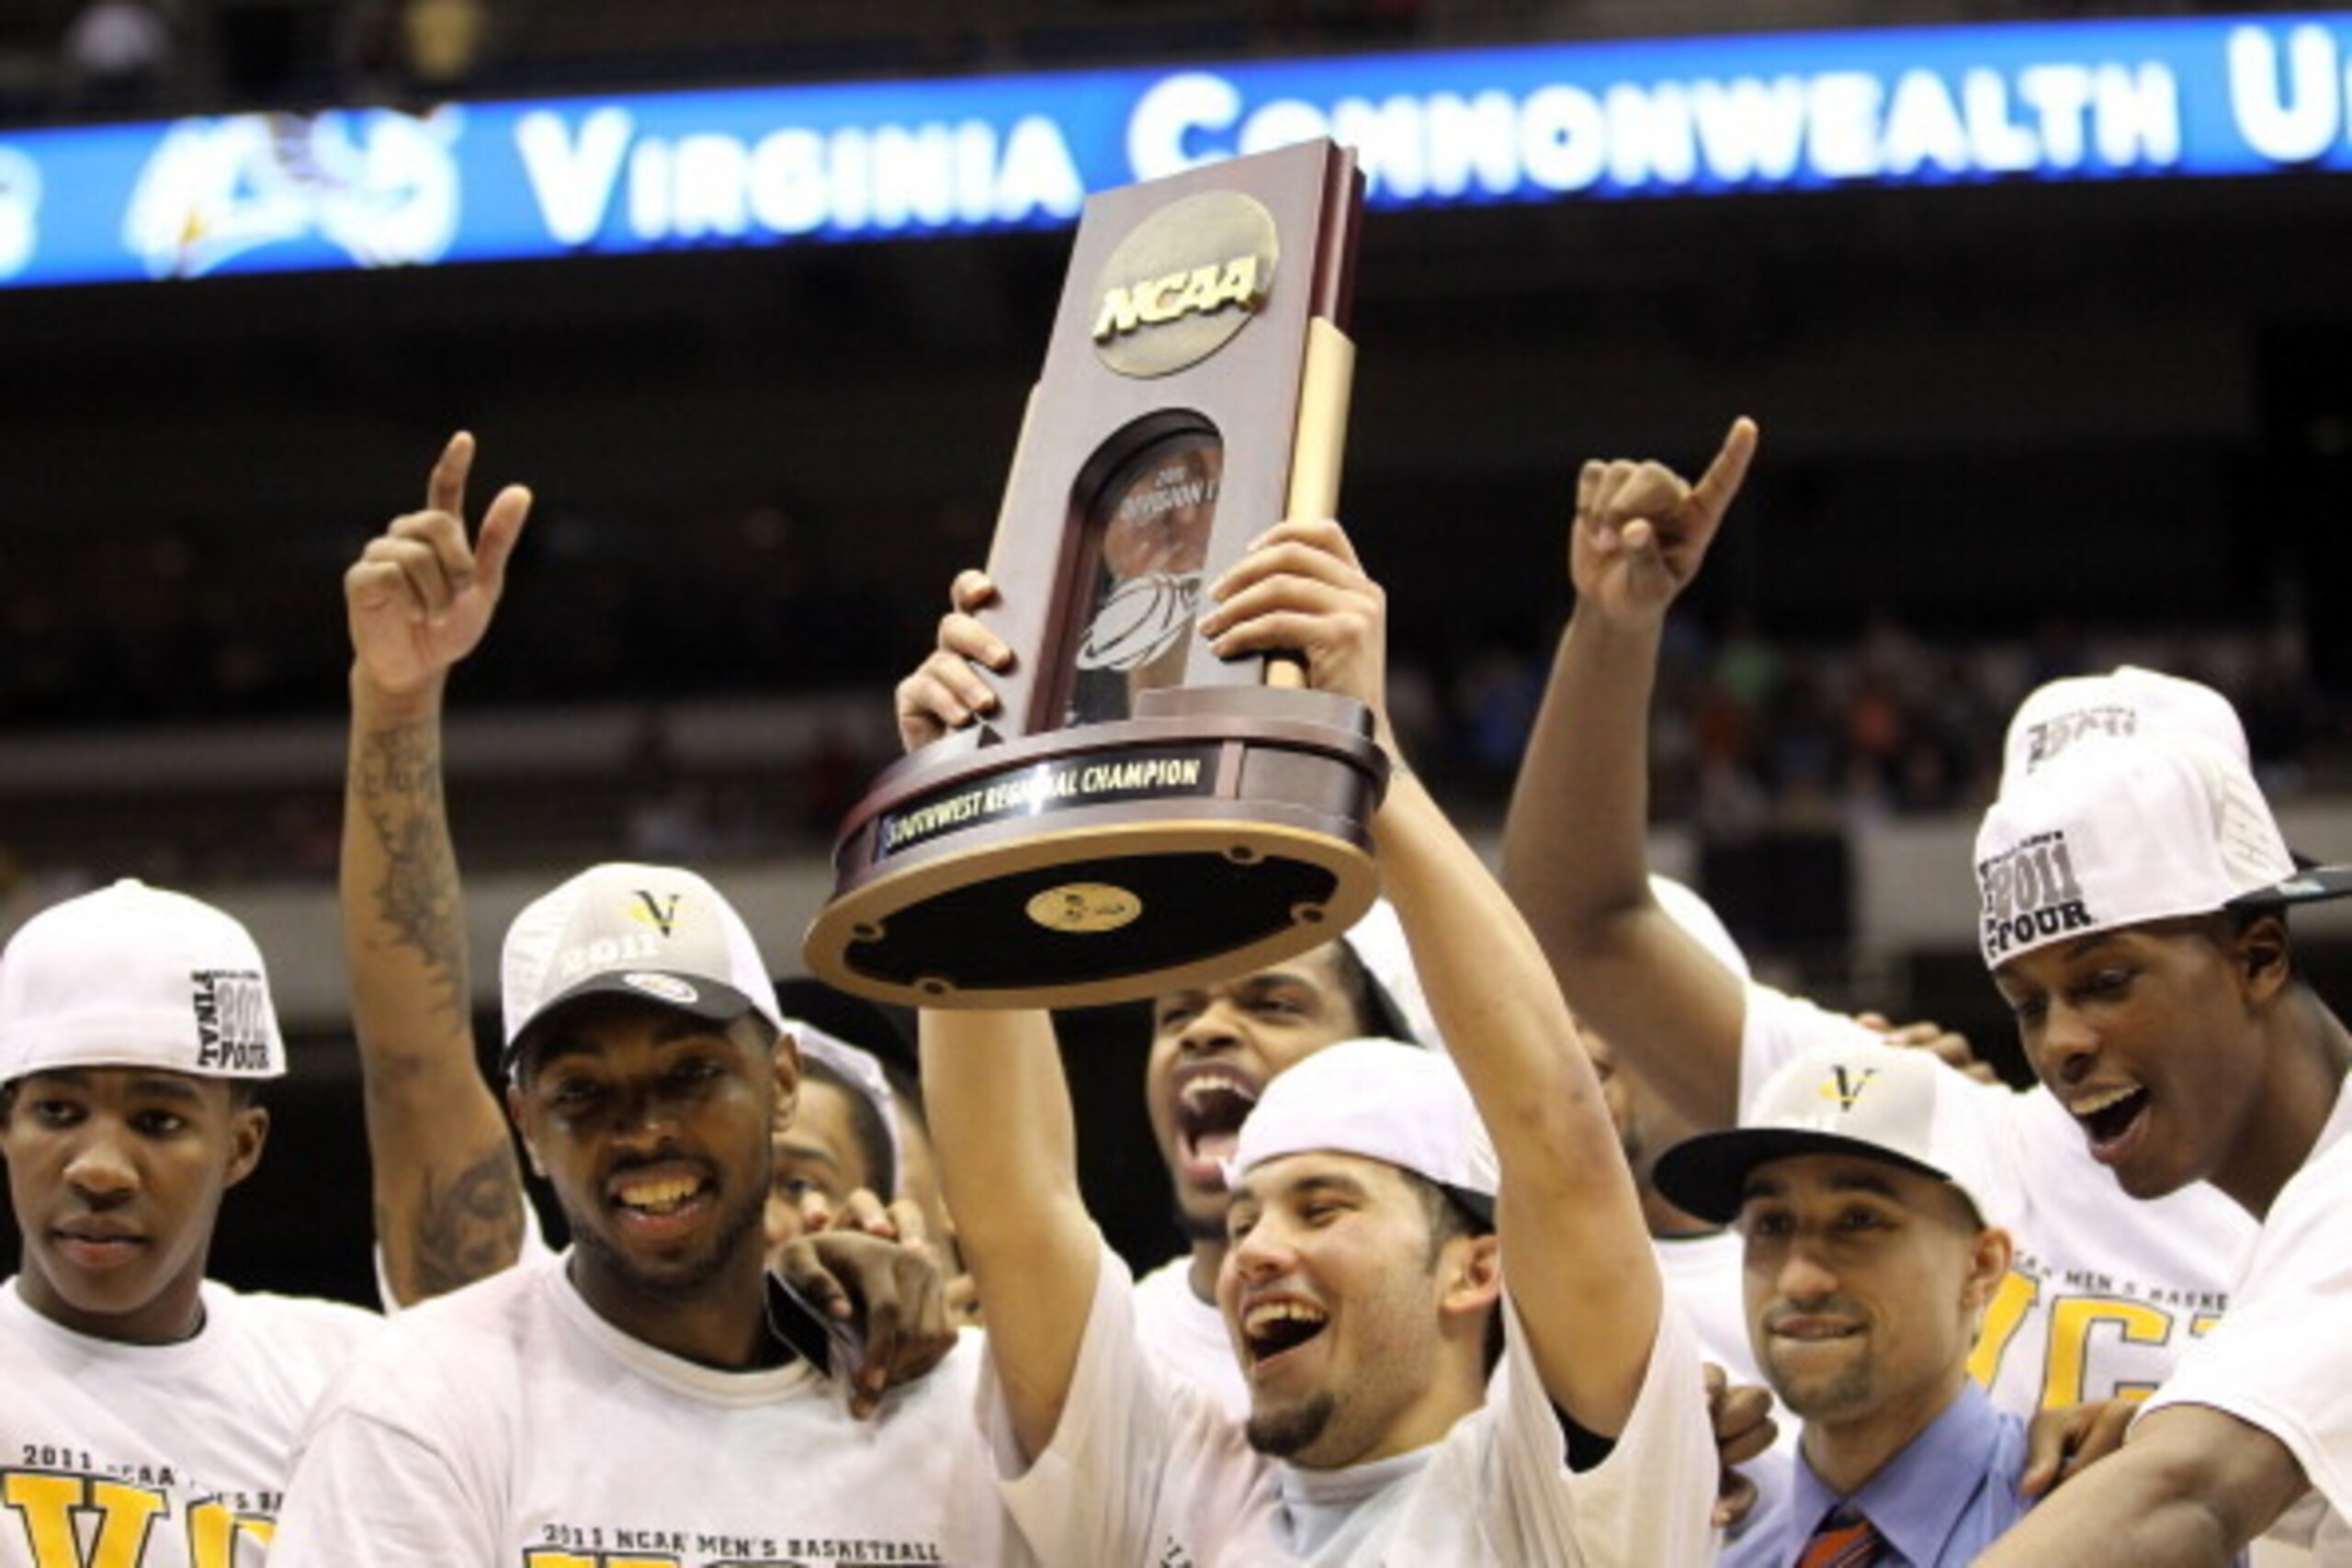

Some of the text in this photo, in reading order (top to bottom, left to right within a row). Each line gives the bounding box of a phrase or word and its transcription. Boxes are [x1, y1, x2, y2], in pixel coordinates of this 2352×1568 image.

[514, 107, 1085, 244] VIRGINIA
[2227, 24, 2352, 163] U
[1091, 256, 1259, 340] NCAA
[984, 768, 1079, 812] REGAL
[1080, 760, 1201, 793] CHAMPION
[1991, 843, 2083, 918] 2011
[1998, 900, 2092, 951] FOUR
[190, 970, 219, 1066] FINAL
[219, 1042, 270, 1069] FOUR
[23, 1445, 91, 1469] 2011
[542, 1524, 942, 1561] 2011 NCAA MEN'S BASKETBALL
